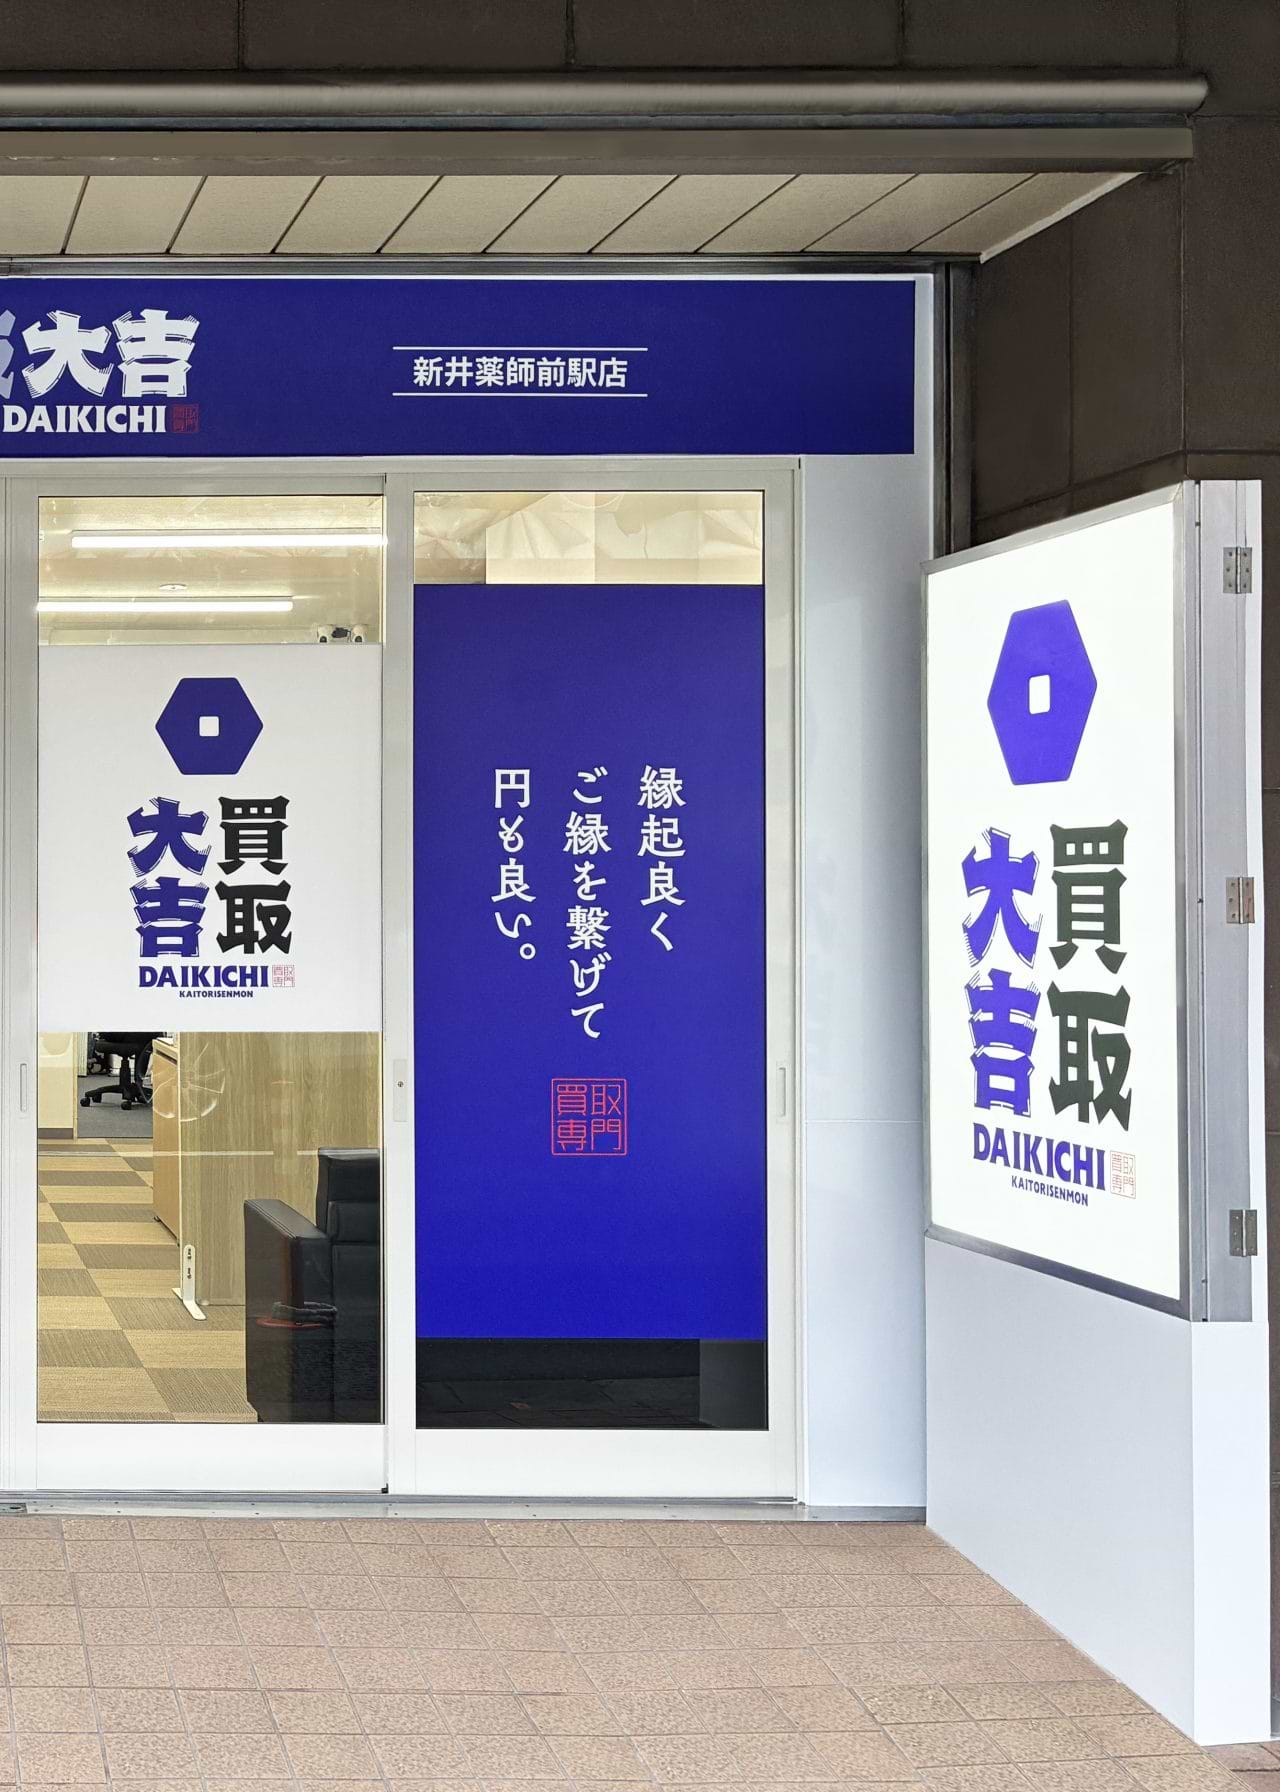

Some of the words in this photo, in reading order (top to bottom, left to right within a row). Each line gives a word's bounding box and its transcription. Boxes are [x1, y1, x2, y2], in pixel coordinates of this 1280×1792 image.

[3, 405, 166, 433] DAIKICHI
[414, 356, 627, 387] 新井薬師前駅店
[127, 797, 211, 957] 大吉
[215, 796, 292, 954] 買取
[492, 769, 536, 959] 円も良い。
[563, 767, 611, 1038] ご縁を繋げて
[638, 765, 686, 950] 縁起良く
[139, 966, 268, 987] DAIKICHI
[179, 990, 254, 998] KAITORISENMON
[962, 827, 1041, 1118] 大吉
[1047, 819, 1132, 1131] 買取
[557, 1084, 621, 1115] 買取
[973, 1122, 1106, 1191] DAIKICHI
[1011, 1175, 1089, 1207] KAITORISENMON
